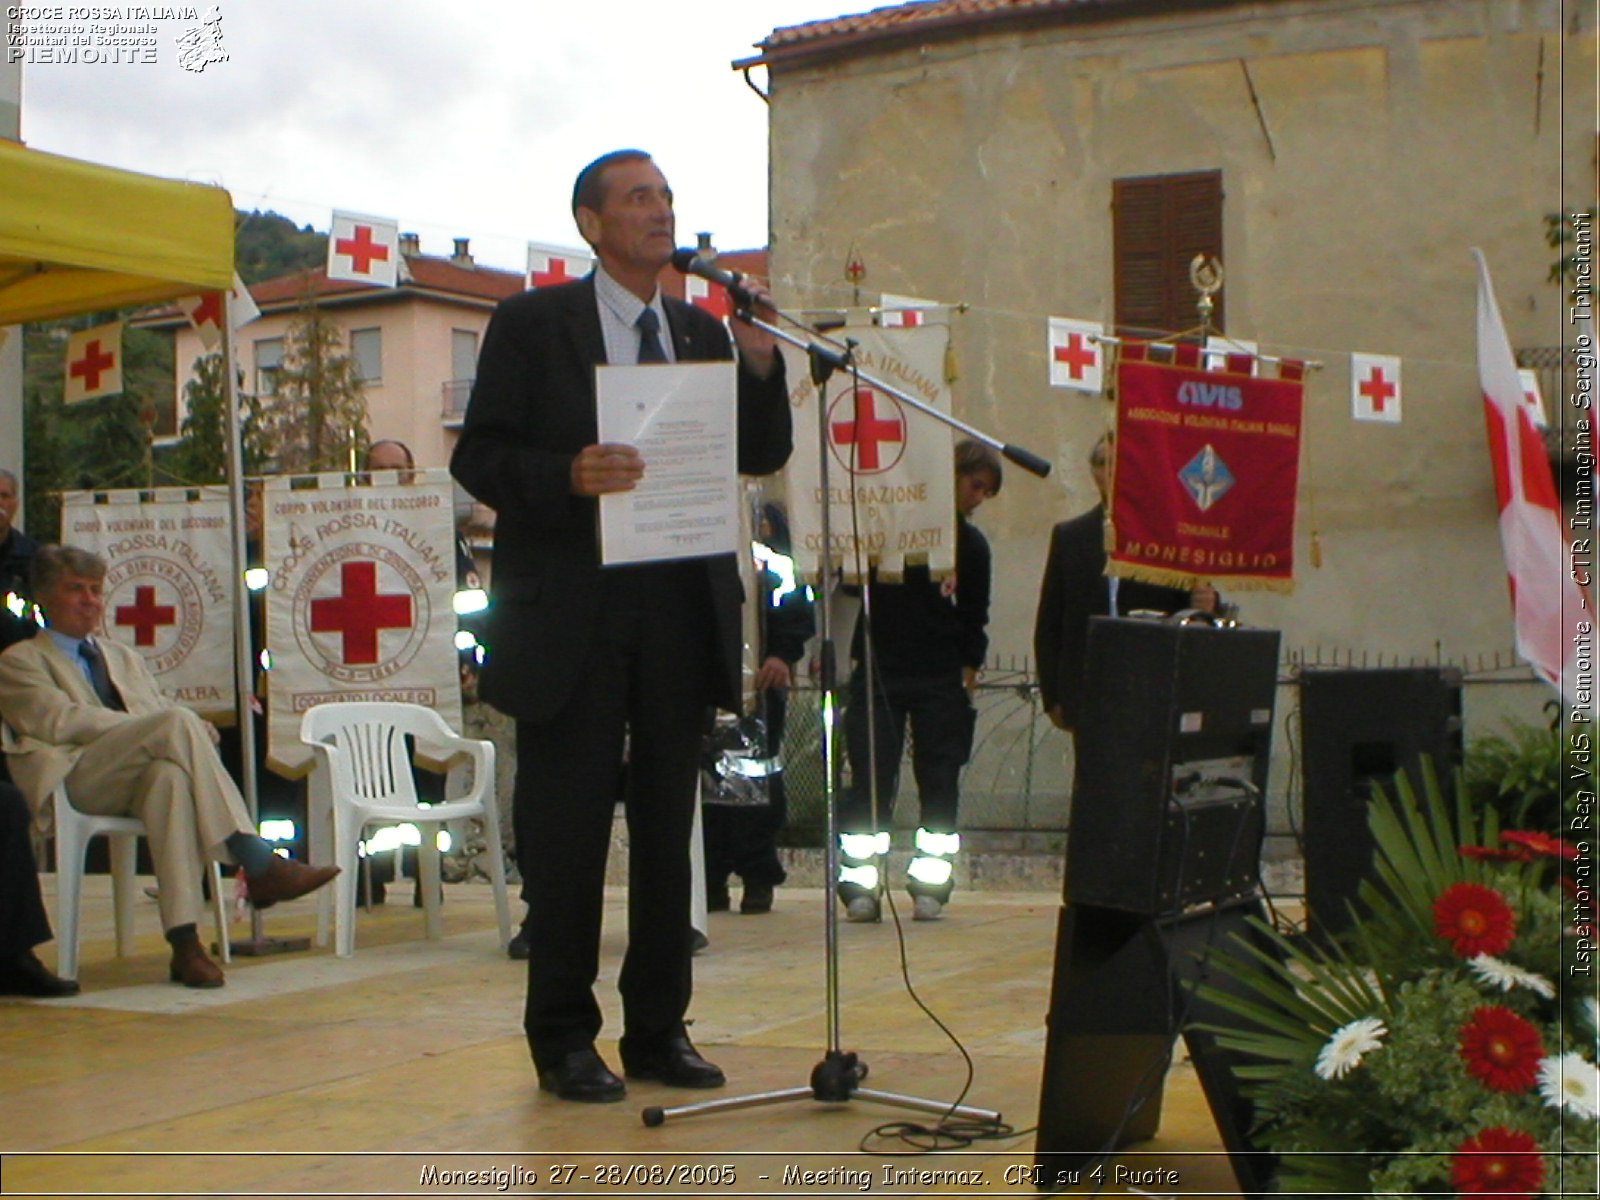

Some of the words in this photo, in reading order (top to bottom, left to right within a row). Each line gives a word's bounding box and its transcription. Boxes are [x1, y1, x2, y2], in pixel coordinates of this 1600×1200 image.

[1177, 380, 1243, 411] AVIS
[316, 512, 378, 541] ROSSA
[383, 518, 448, 584] ITALIANA
[1125, 541, 1277, 567] MONESIGLIO
[106, 534, 168, 559] ROSSA
[171, 538, 225, 604] ITALIANA
[174, 685, 221, 701] ALBA
